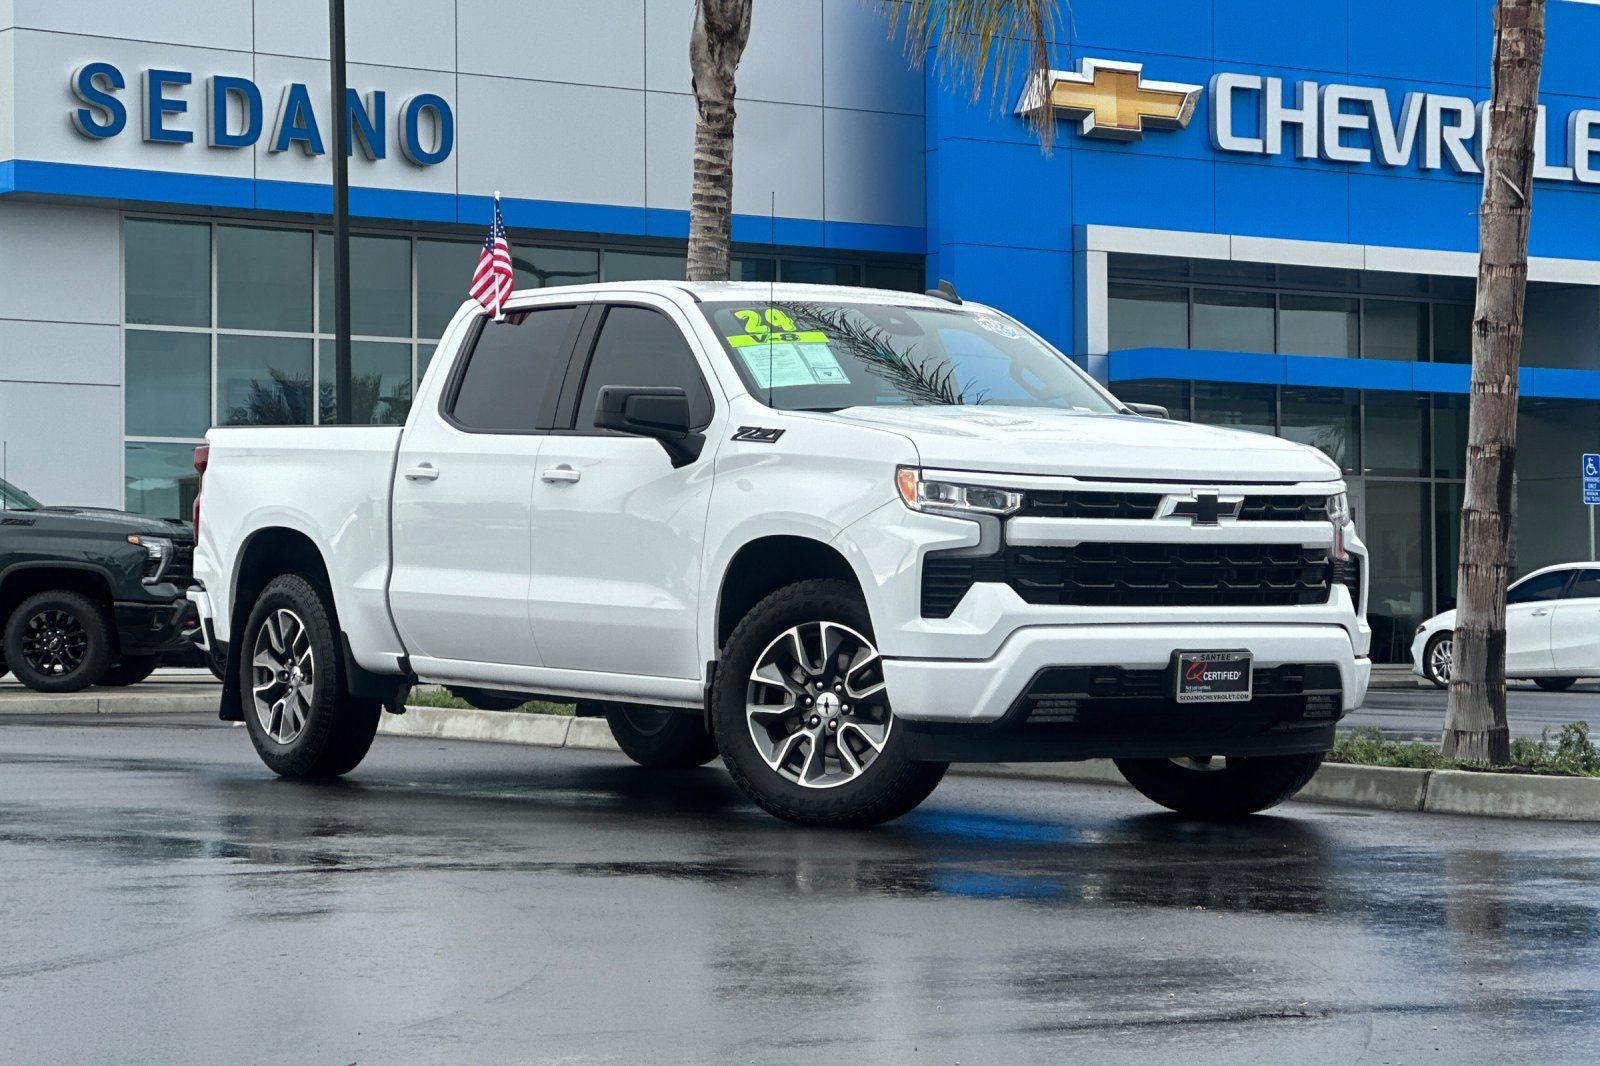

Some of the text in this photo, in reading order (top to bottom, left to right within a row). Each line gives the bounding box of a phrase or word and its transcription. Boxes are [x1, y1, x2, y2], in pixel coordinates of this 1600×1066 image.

[71, 62, 454, 167] SEDANO
[1210, 72, 1600, 184] CHEVRLE
[734, 308, 797, 334] 24
[750, 333, 800, 344] V-8
[1200, 653, 1231, 661] SANTEE
[1202, 671, 1240, 681] CERTIFIED
[1179, 693, 1249, 701] SEDANOCHEVROLET.COM
